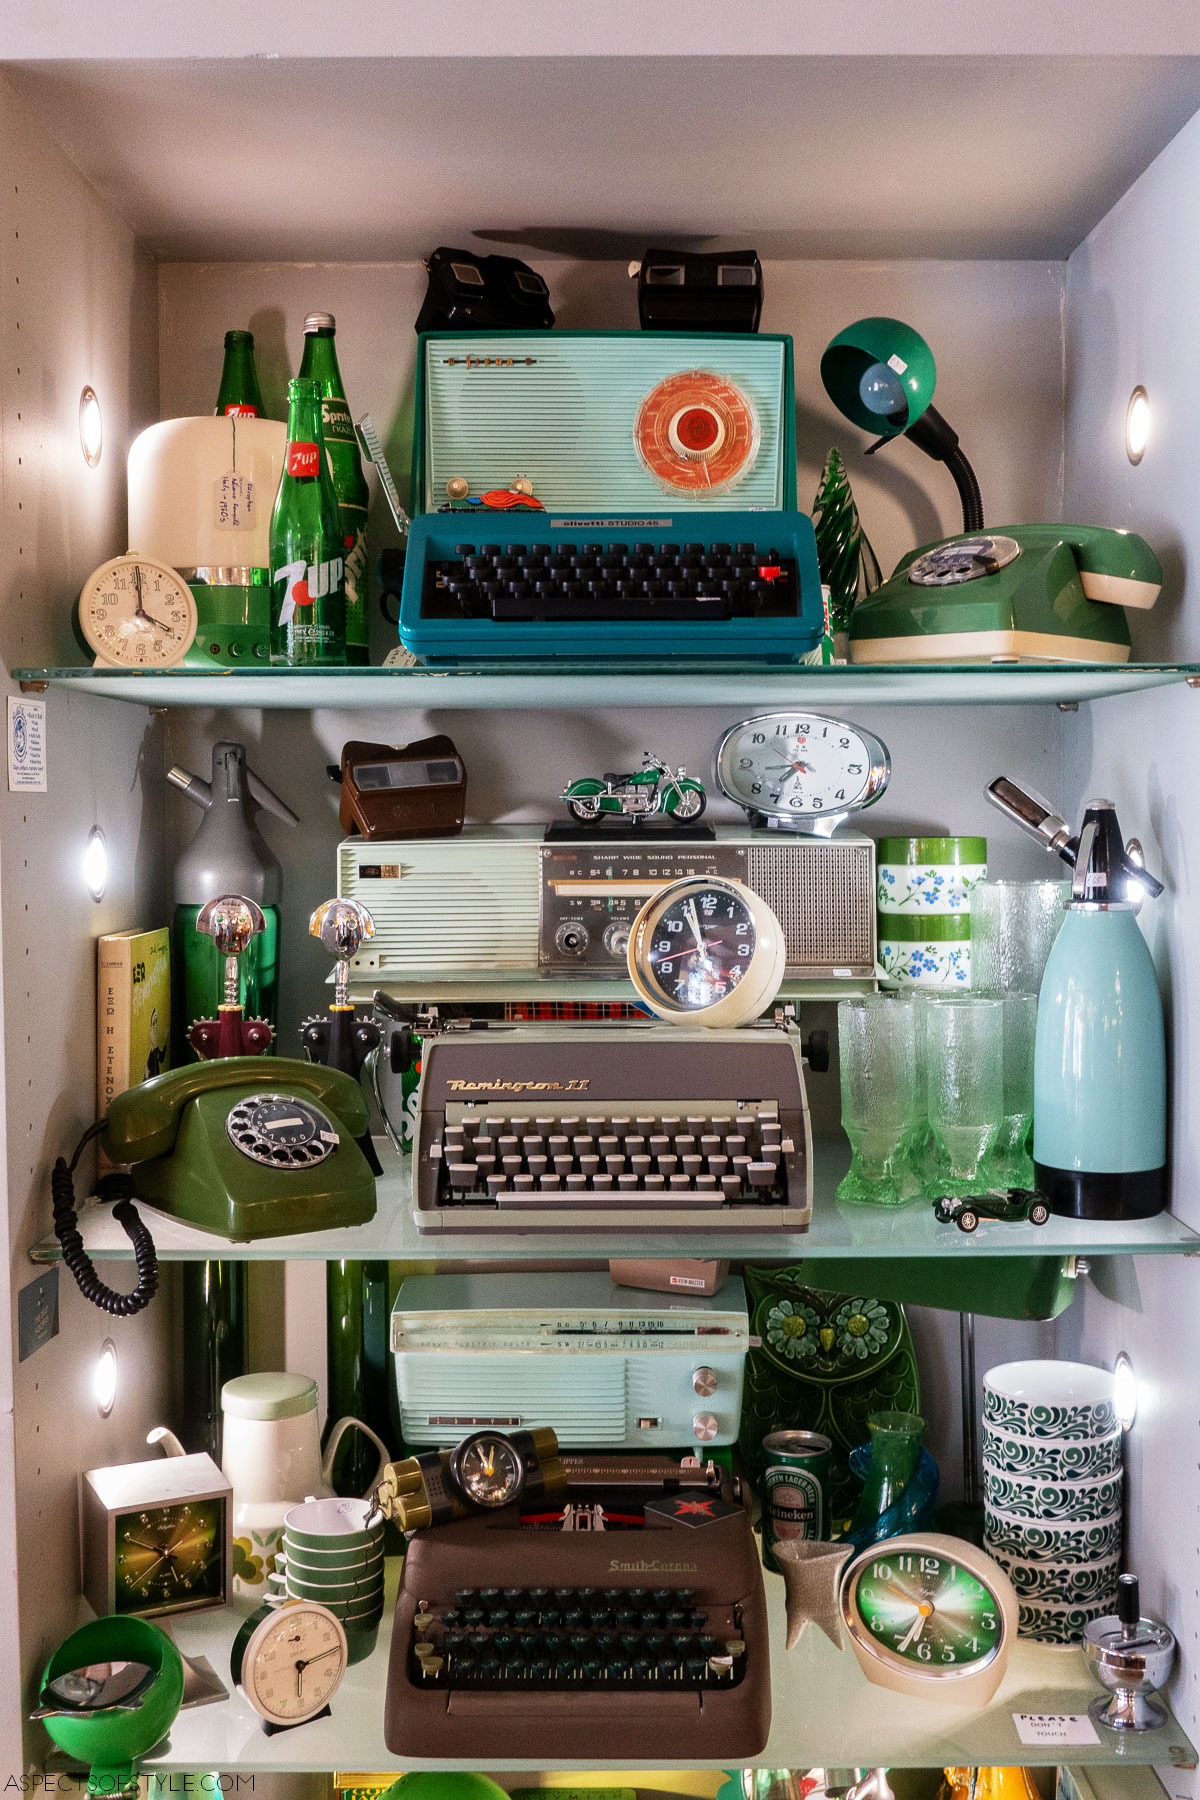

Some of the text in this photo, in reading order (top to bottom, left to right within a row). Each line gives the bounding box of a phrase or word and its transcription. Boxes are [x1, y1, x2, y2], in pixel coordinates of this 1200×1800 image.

[114, 578, 127, 590] 11
[154, 580, 161, 592] 1
[102, 593, 118, 605] 10
[165, 594, 175, 606] 2
[96, 609, 107, 620] 9
[171, 611, 181, 622] 3
[104, 625, 115, 638] 8
[119, 638, 129, 651] 7
[136, 644, 146, 656] 6
[153, 640, 163, 652] 5
[776, 725, 787, 736] 11
[795, 723, 811, 735] 12
[822, 727, 828, 738] 1
[752, 733, 766, 744] 10
[839, 738, 850, 749] 2
[740, 758, 753, 769] 9
[848, 764, 862, 775] 3
[751, 783, 762, 795] 8
[835, 789, 845, 800] 4
[769, 793, 782, 804] 7
[789, 795, 804, 808] 6
[812, 798, 824, 809] 5
[700, 897, 718, 909] 12
[727, 907, 735, 919] 1
[667, 920, 683, 933] 10
[736, 923, 748, 935] 2
[659, 941, 671, 953] 9
[737, 944, 750, 957] 3
[661, 962, 673, 974] 8
[729, 965, 741, 977] 4
[674, 979, 685, 991] 7
[446, 1078, 563, 1093] Remington
[785, 1475, 808, 1489] LAGER
[899, 1555, 912, 1573] 11
[920, 1557, 940, 1575] 12
[873, 1563, 892, 1580] 10
[950, 1565, 956, 1581] 1
[861, 1587, 875, 1602] 9
[969, 1582, 984, 1600] 2
[870, 1615, 885, 1632] 8
[981, 1612, 996, 1630] 3
[965, 1637, 981, 1653] 4
[917, 1642, 932, 1661] 6
[941, 1645, 956, 1662] 5
